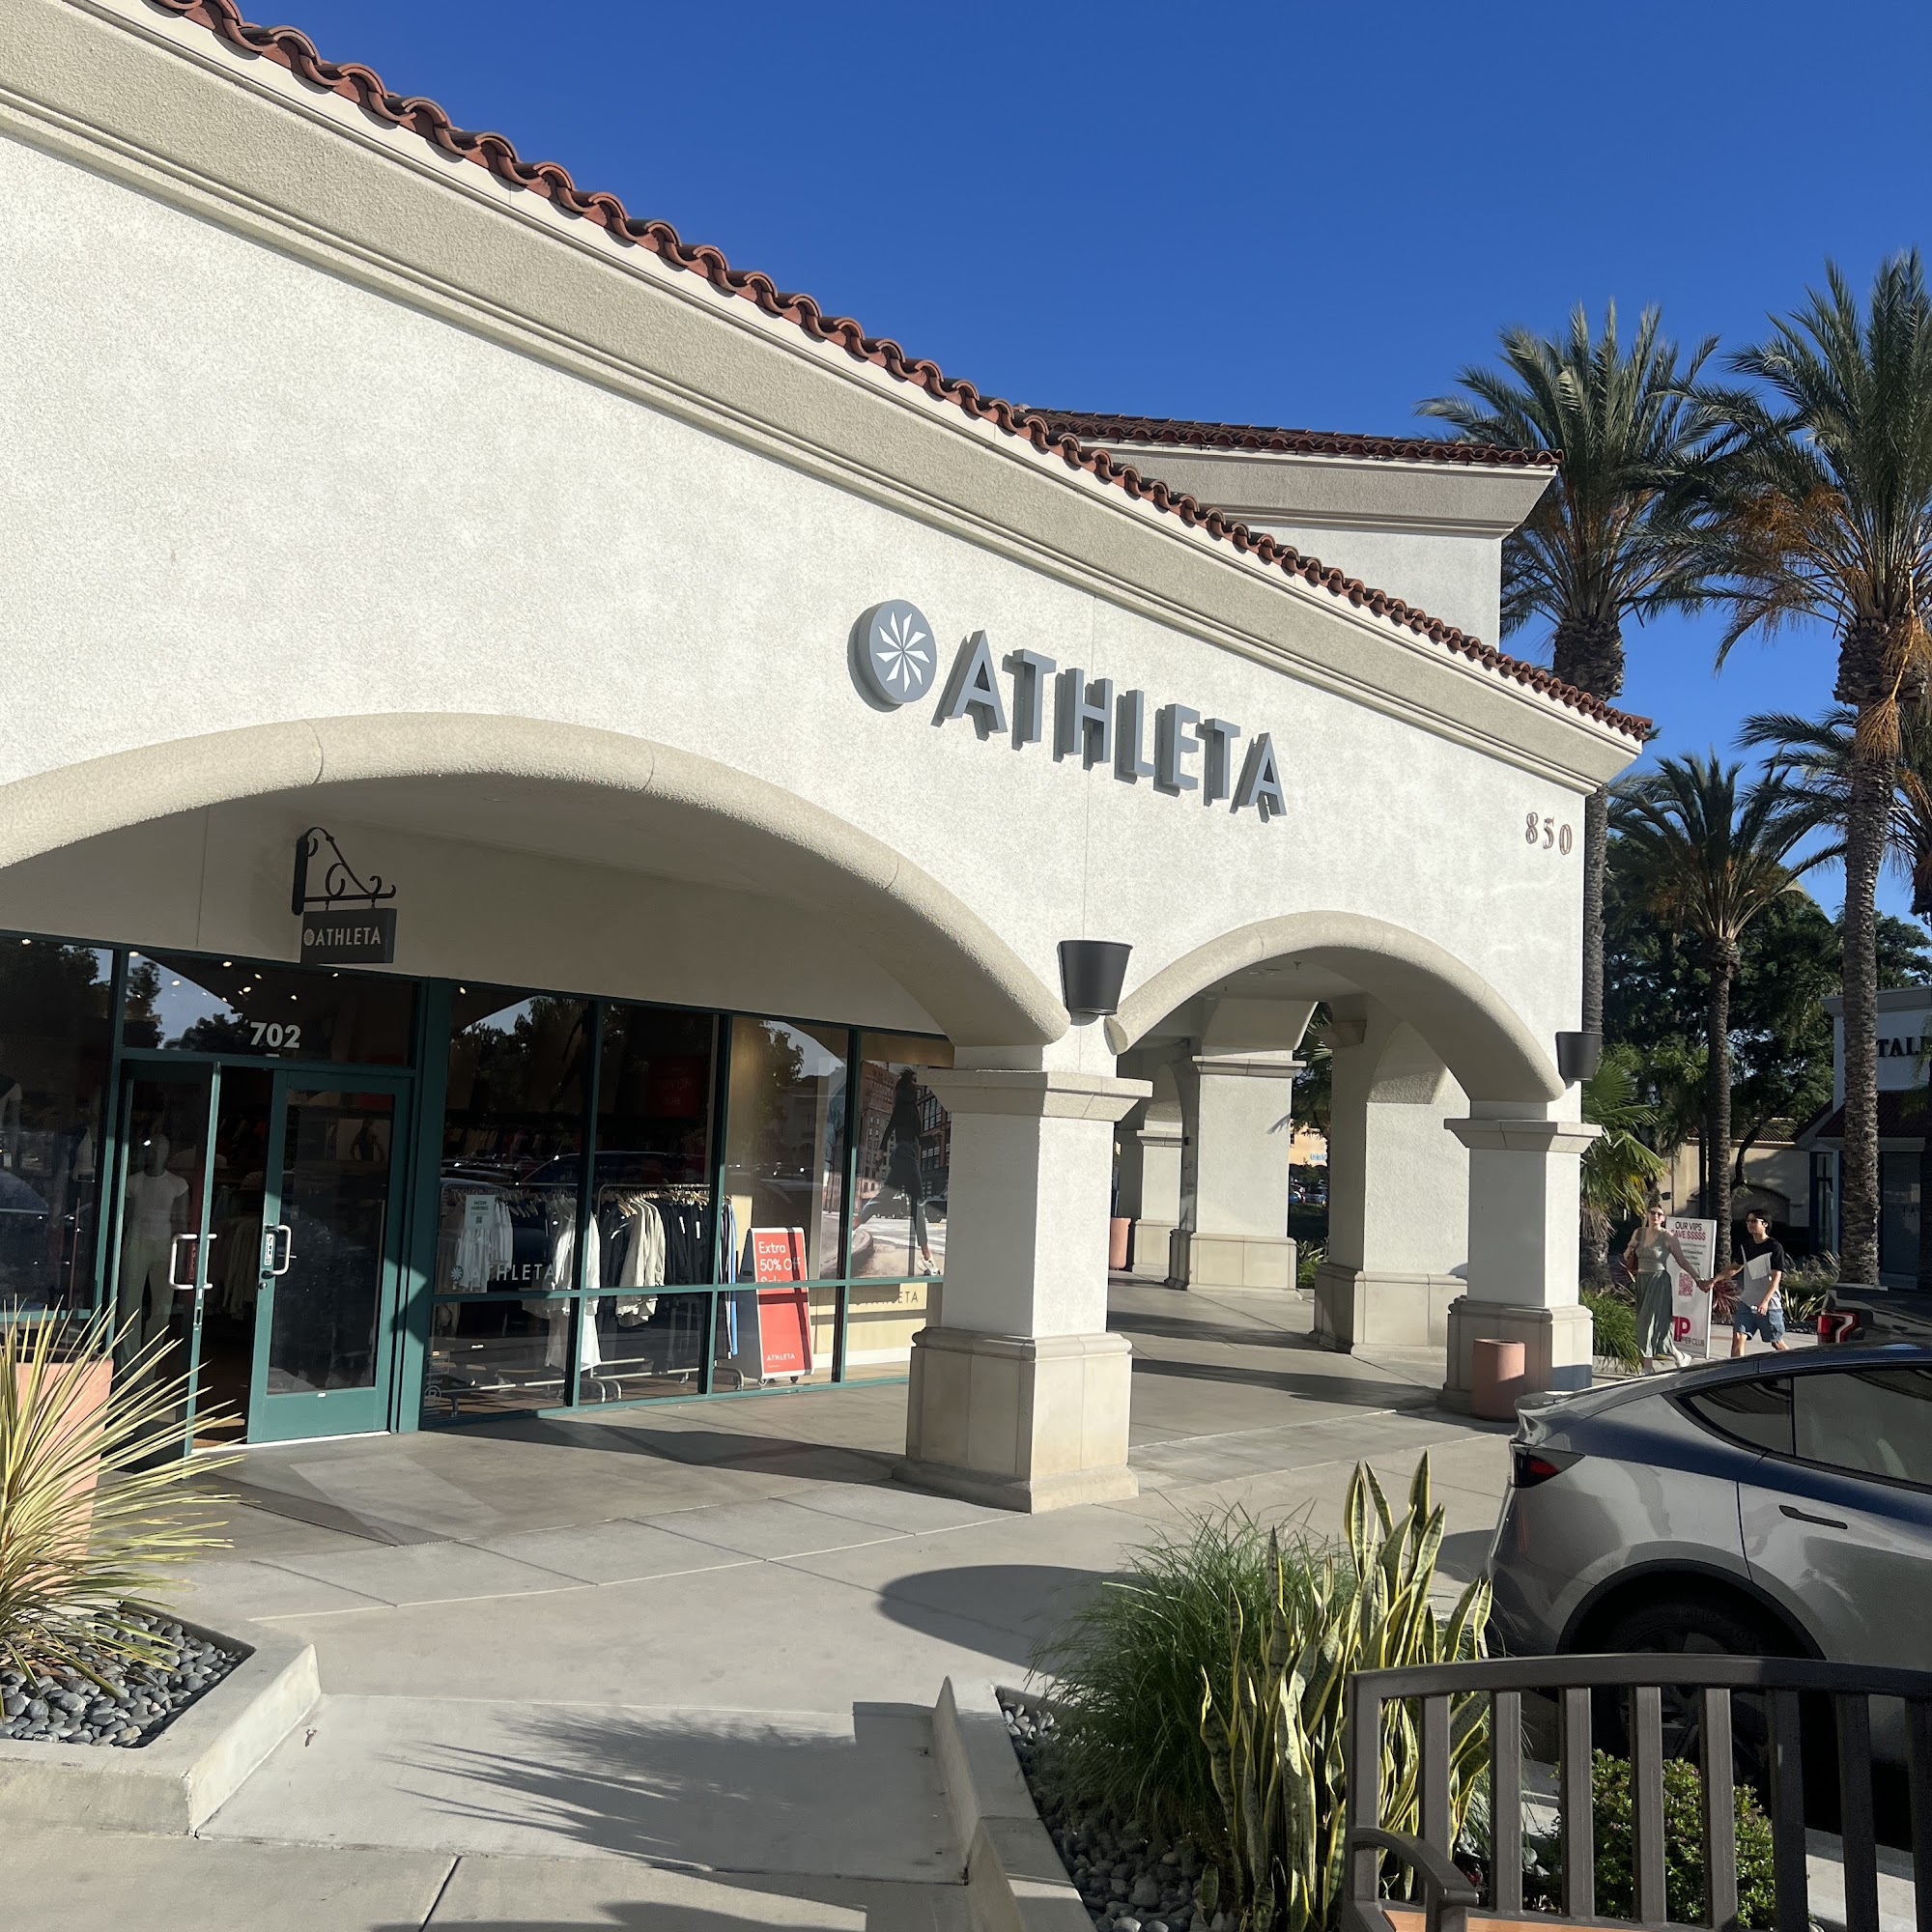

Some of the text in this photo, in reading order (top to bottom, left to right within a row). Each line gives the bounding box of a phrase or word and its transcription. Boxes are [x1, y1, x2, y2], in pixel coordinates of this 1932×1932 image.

[930, 629, 1288, 823] ATHLETA
[1525, 811, 1573, 856] 850
[314, 926, 382, 947] ATHLETA
[250, 1021, 301, 1049] 702
[1675, 1221, 1689, 1231] OUR
[758, 1240, 786, 1254] Extra
[759, 1256, 801, 1272] 50% Off
[1691, 1337, 1705, 1347] CLUB
[766, 1352, 796, 1362] ATHLETA
